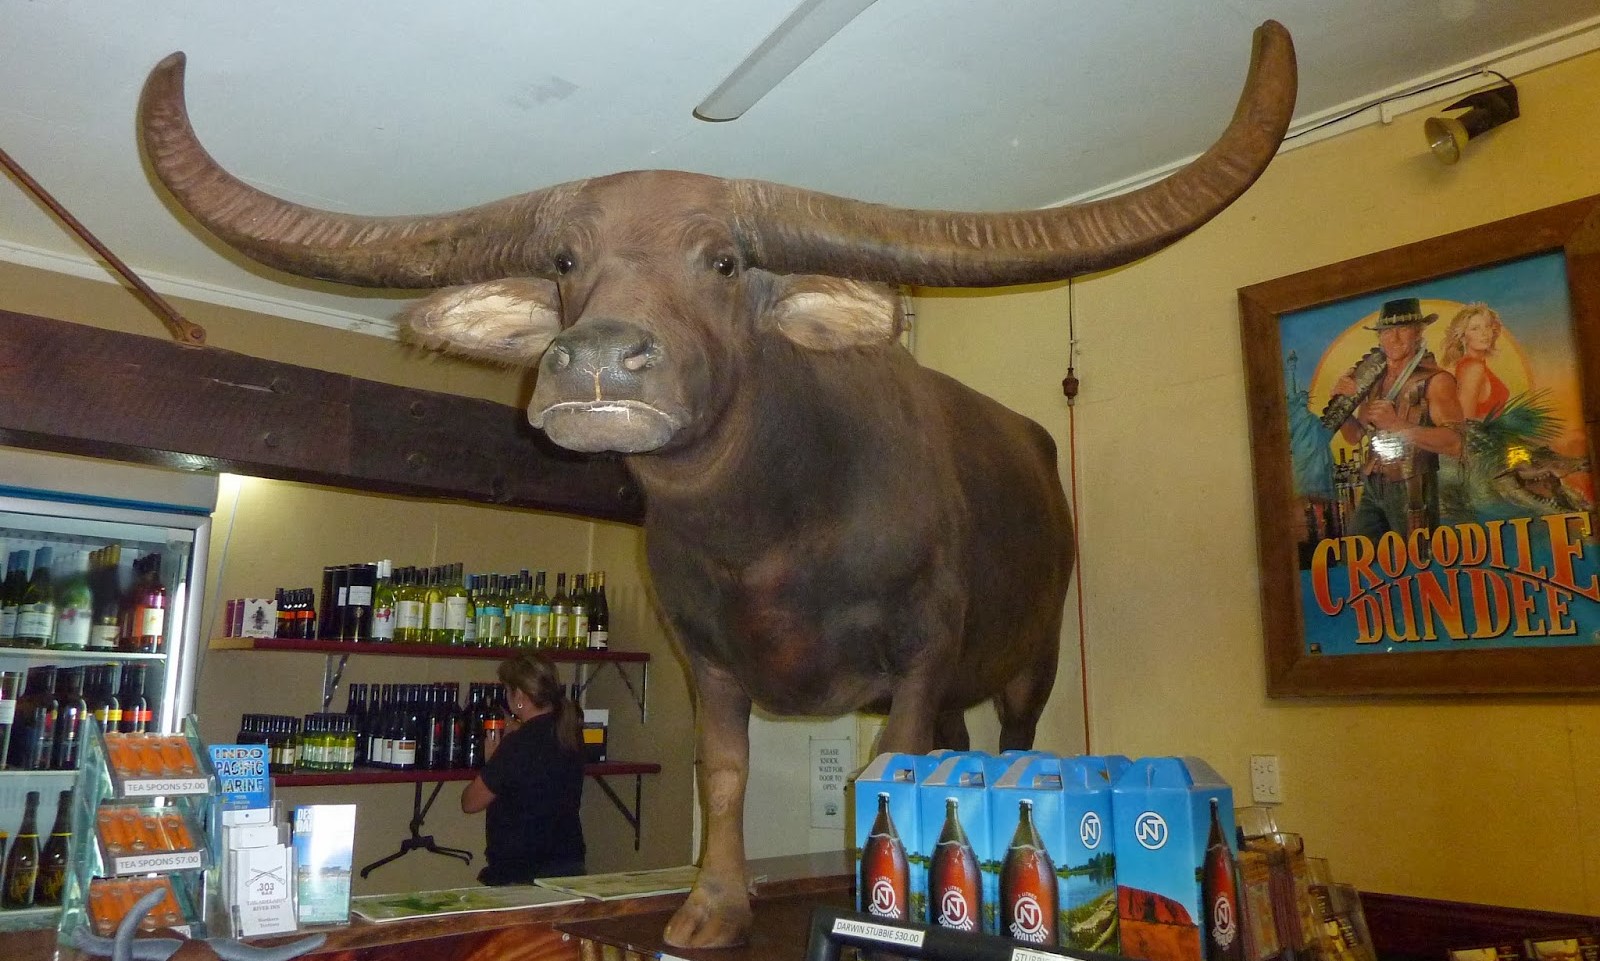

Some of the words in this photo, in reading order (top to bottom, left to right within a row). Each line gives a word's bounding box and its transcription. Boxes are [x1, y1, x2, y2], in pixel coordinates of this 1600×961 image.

[1311, 511, 1600, 616] CROCODILE
[1351, 568, 1577, 644] DUNDEE
[215, 748, 263, 759] INDO
[820, 748, 840, 756] PLEASE
[215, 761, 265, 776] PACIFIC
[127, 784, 144, 792] TEA
[145, 783, 181, 791] SPOONS
[182, 782, 206, 790] $7.00
[120, 860, 137, 868] TEA
[139, 857, 174, 867] SPOONS
[175, 855, 199, 864] $7.00
[257, 882, 275, 891] .303
[836, 921, 864, 934] DARWIN
[865, 925, 894, 939] STUBBIE
[894, 930, 920, 943] $30.00
[1009, 922, 1049, 943] DRAUGHT
